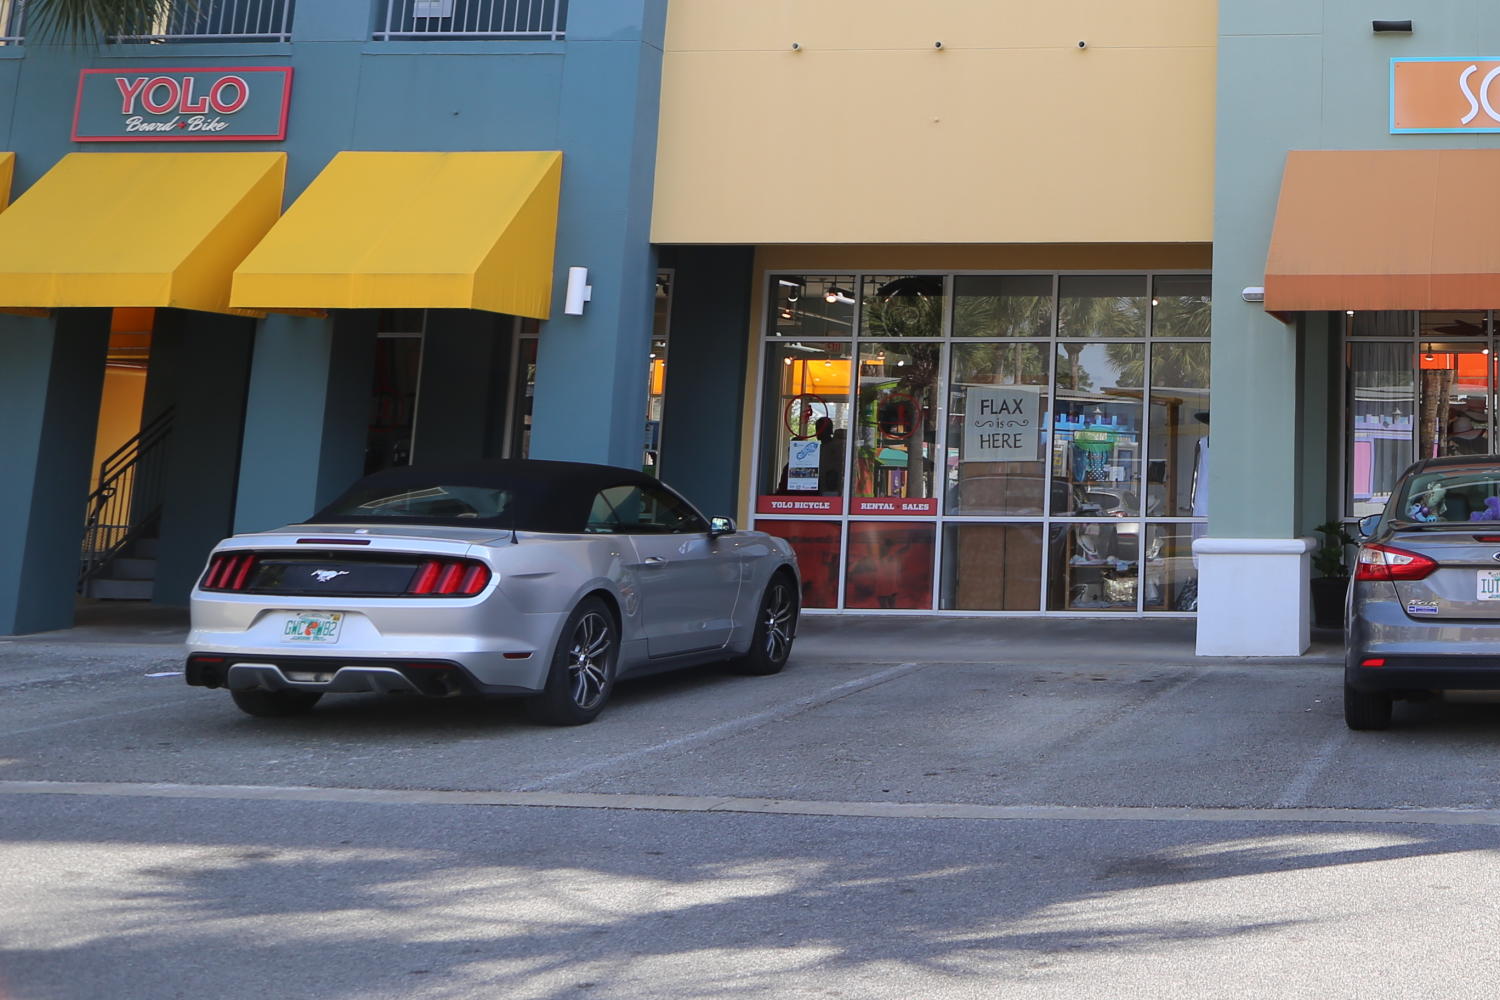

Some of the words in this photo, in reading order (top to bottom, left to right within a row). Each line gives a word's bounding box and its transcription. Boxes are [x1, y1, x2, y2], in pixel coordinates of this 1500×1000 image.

[115, 75, 249, 115] YOLO
[126, 115, 181, 133] Board
[188, 115, 229, 132] Bike
[980, 398, 1023, 415] FLAX
[996, 417, 1005, 429] is
[980, 433, 1023, 449] HERE
[771, 501, 794, 509] YOLO
[795, 501, 831, 510] BICYCLE
[860, 502, 895, 511] RENTAL
[902, 503, 930, 511] SALES
